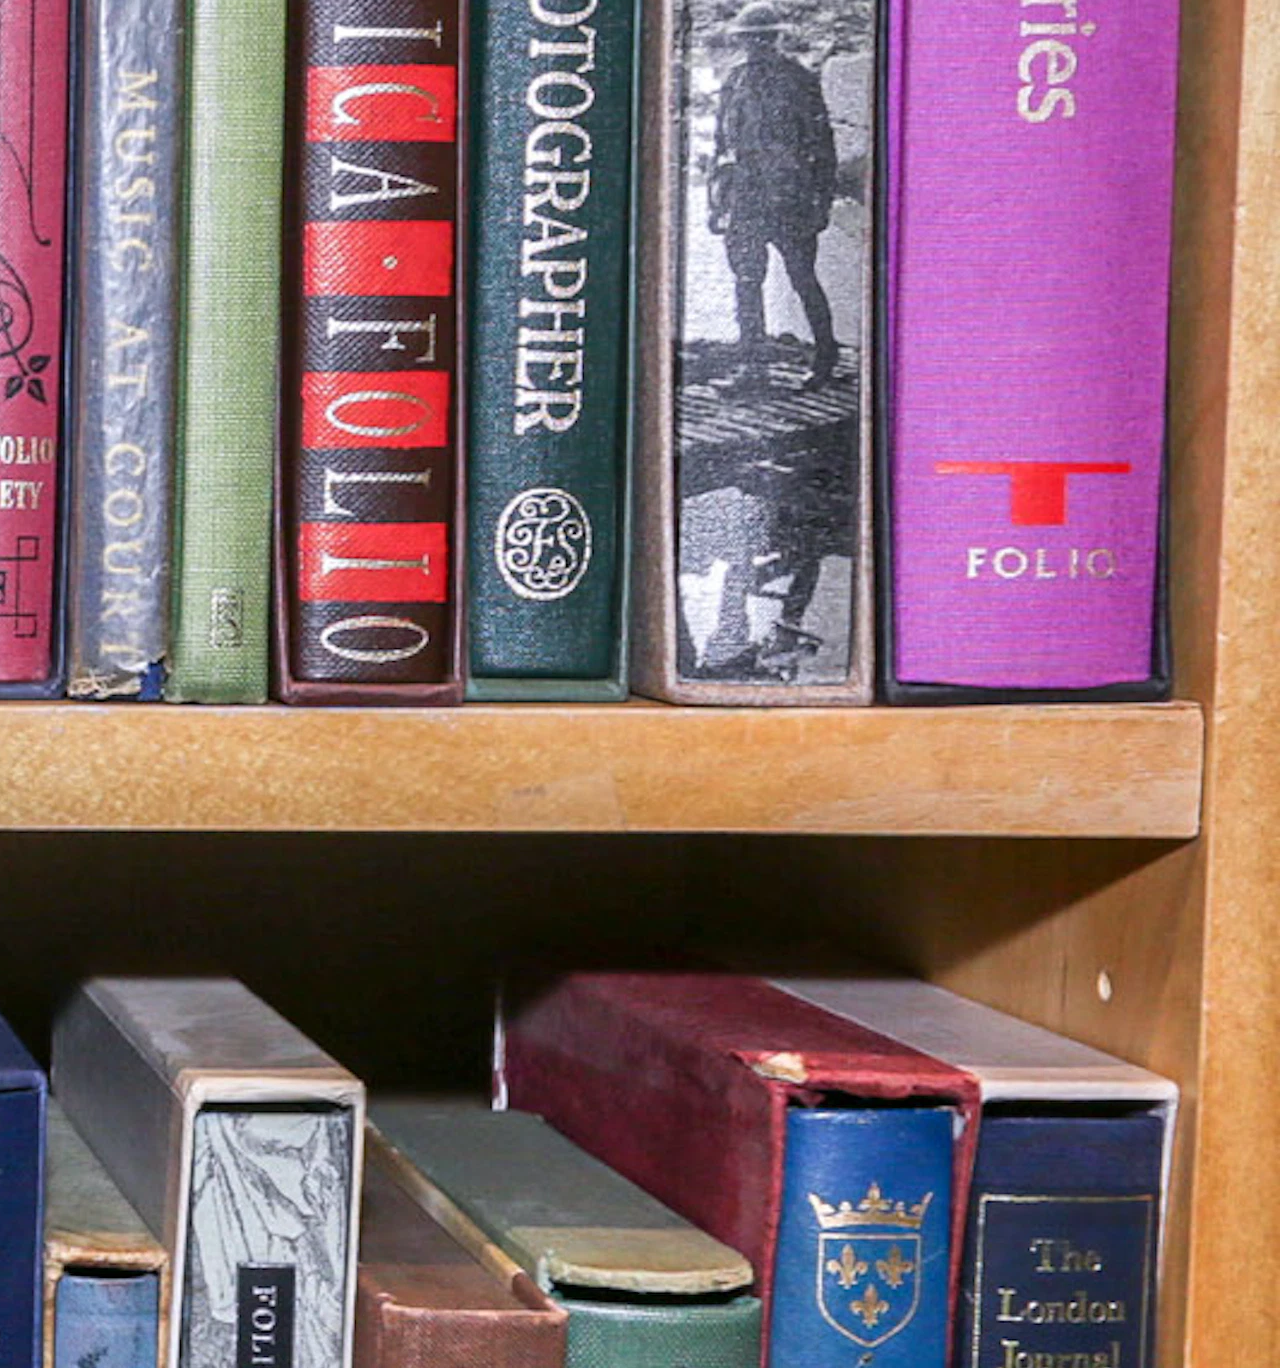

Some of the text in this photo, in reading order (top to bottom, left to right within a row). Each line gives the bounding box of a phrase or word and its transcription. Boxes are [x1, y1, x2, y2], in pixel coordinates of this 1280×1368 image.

[321, 312, 436, 663] FOLIO
[966, 547, 1115, 578] FOLIO
[997, 1288, 1126, 1323] London
